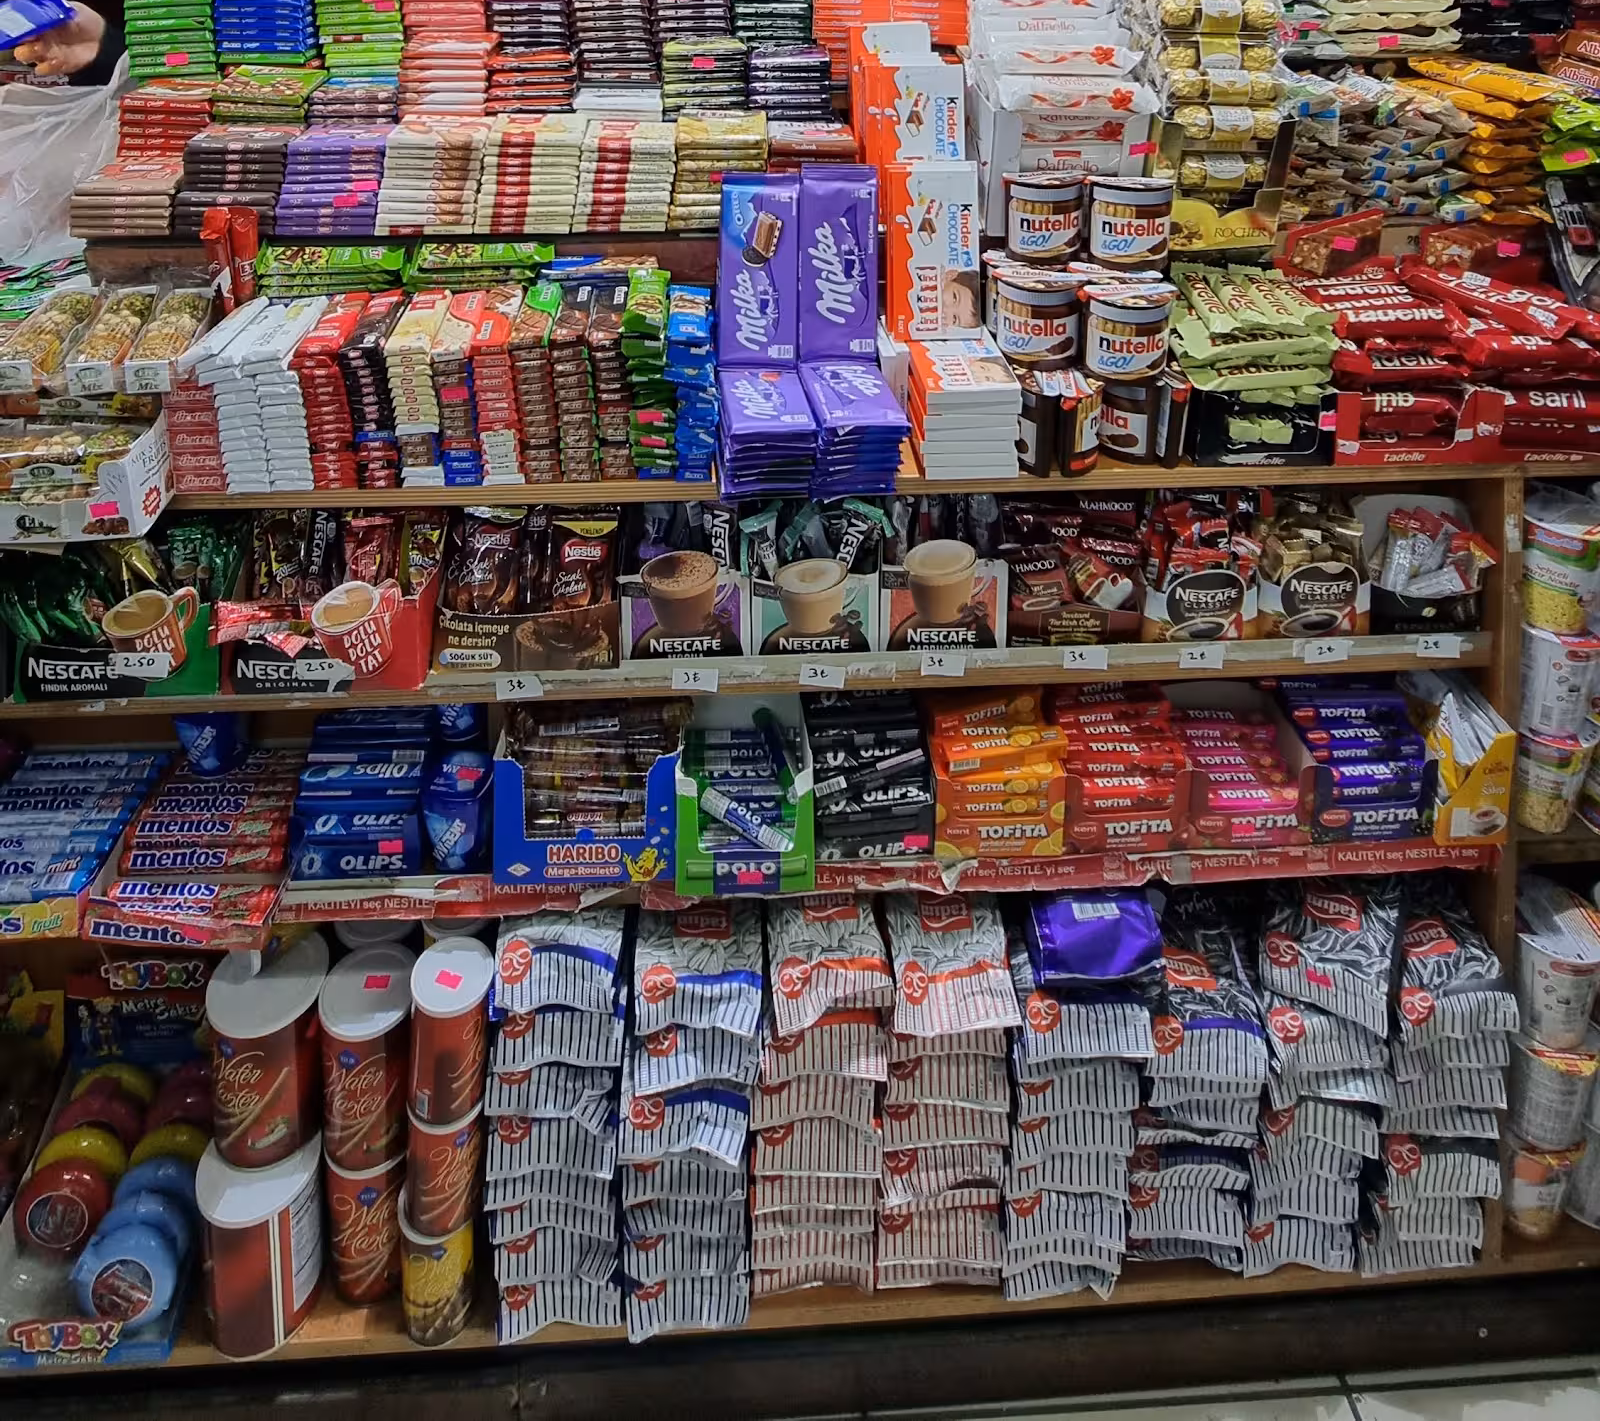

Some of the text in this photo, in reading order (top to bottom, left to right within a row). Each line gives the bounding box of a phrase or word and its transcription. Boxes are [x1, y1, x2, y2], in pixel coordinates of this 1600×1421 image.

[730, 192, 745, 225] OREO
[1020, 216, 1079, 231] nutella
[1101, 220, 1164, 236] nutella
[1213, 227, 1266, 239] ROCHER
[809, 221, 856, 324] Milka
[730, 269, 768, 350] Milka
[1003, 317, 1066, 335] nutella
[1099, 338, 1164, 354] nutella
[730, 379, 778, 419] Milka
[1384, 452, 1425, 462] tadelle
[1080, 500, 1132, 511] MAHMOOD
[344, 621, 376, 644] DOLU
[475, 621, 510, 633] içmeye
[448, 634, 497, 646] ne dersin?
[348, 637, 382, 661] DOLU
[449, 652, 474, 661] SOĞUK
[124, 656, 155, 668] 2.50
[305, 660, 333, 671] 2.50
[359, 653, 383, 673] TAT
[70, 683, 108, 691] AROMALI
[728, 800, 761, 825] POLO
[547, 845, 621, 862] HARIBO
[47, 856, 81, 872] mint
[547, 867, 619, 876] Mega-Roulette
[32, 915, 63, 932] fruit
